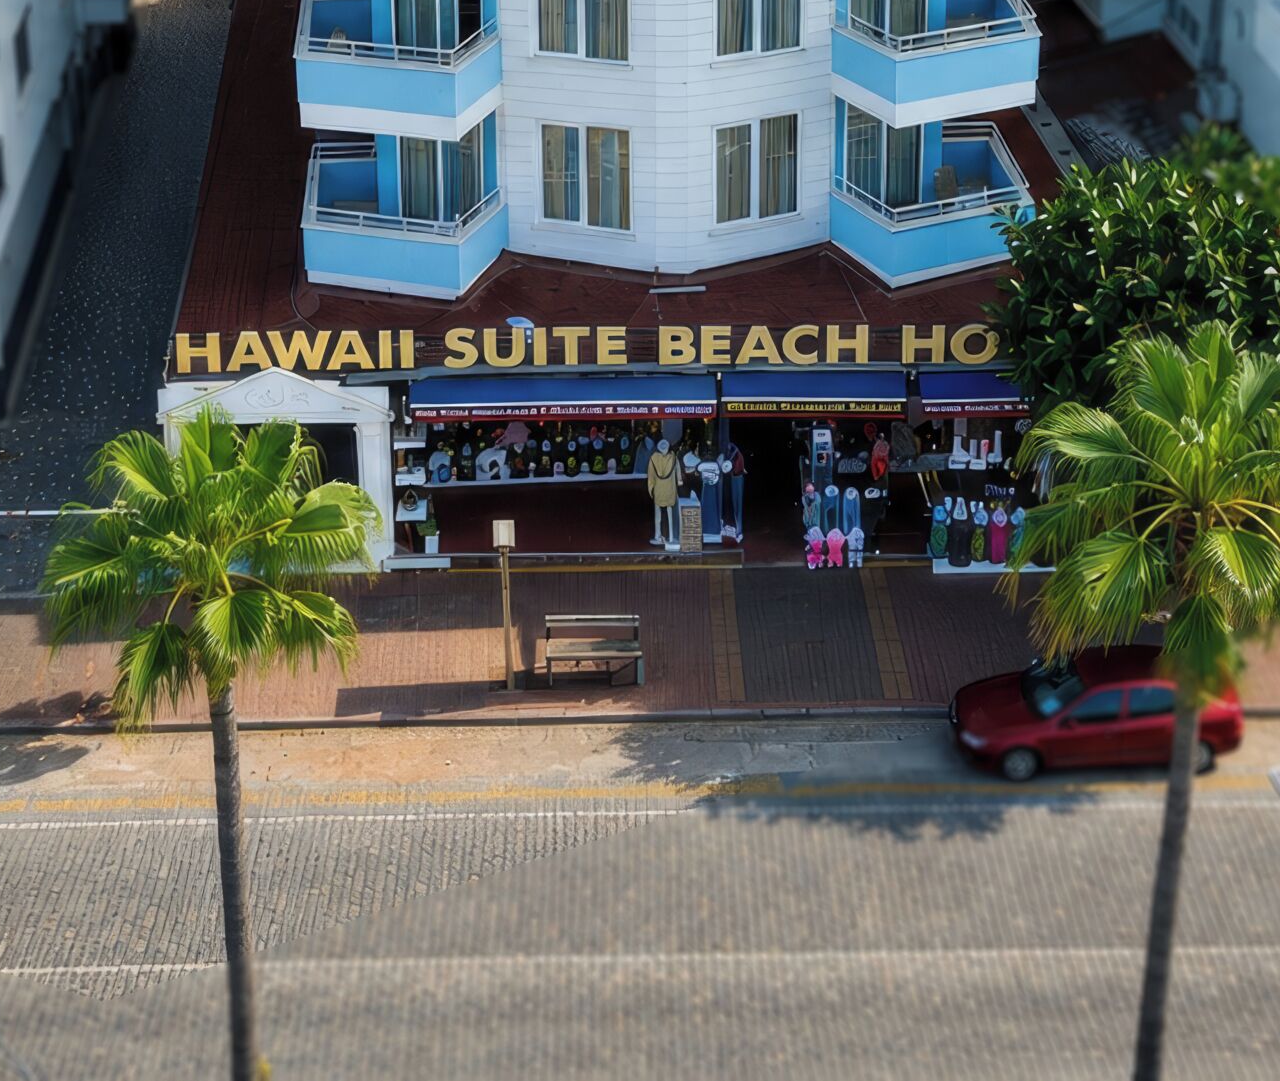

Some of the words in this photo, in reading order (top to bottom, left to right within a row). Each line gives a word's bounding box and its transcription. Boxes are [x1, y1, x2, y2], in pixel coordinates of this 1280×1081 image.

[175, 329, 415, 373] HAWAII
[443, 326, 628, 369] SUITE
[658, 324, 869, 365] BEACH
